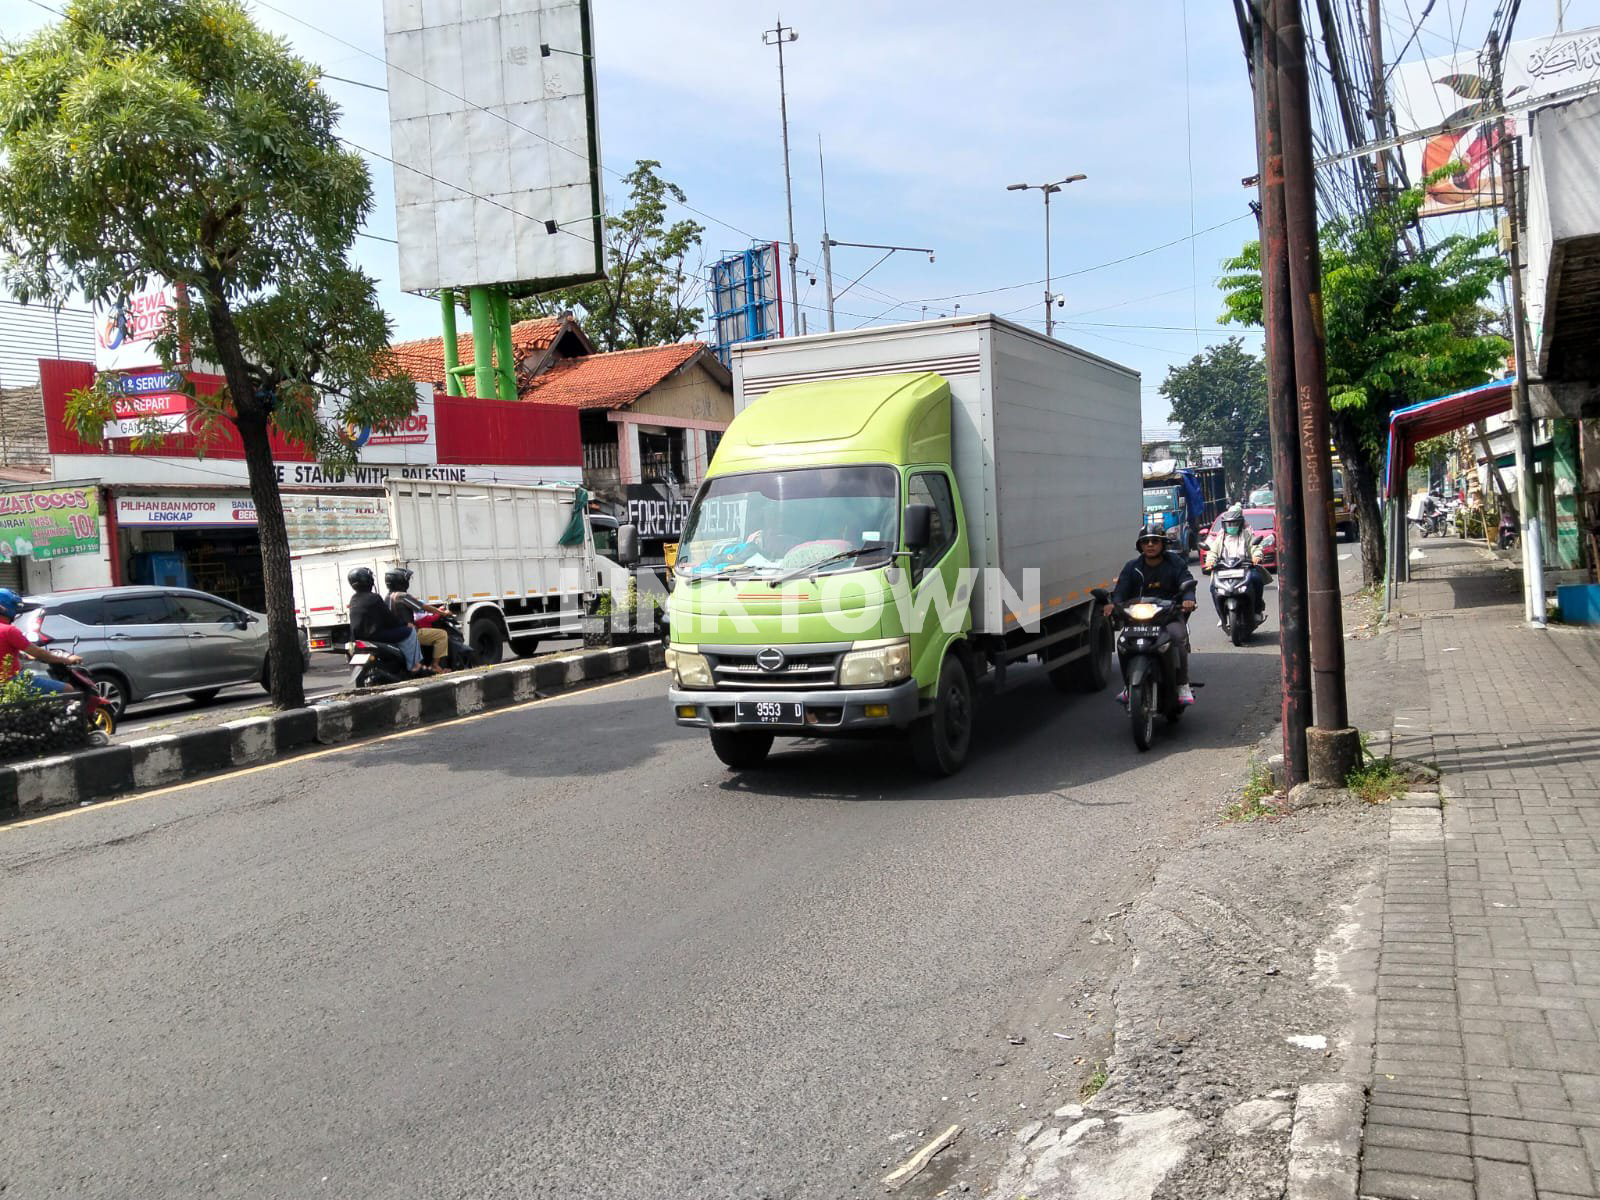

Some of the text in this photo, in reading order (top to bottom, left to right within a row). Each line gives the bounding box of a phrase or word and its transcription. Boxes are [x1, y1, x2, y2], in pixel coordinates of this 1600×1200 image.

[126, 310, 174, 333] MOTO
[136, 373, 176, 391] SERVIC
[354, 467, 390, 484] WITH
[120, 501, 217, 512] PILIHAN BAN MOTOR
[231, 501, 247, 509] BAN
[148, 512, 193, 521] LENGKAP
[737, 702, 802, 717] L 9553 D
